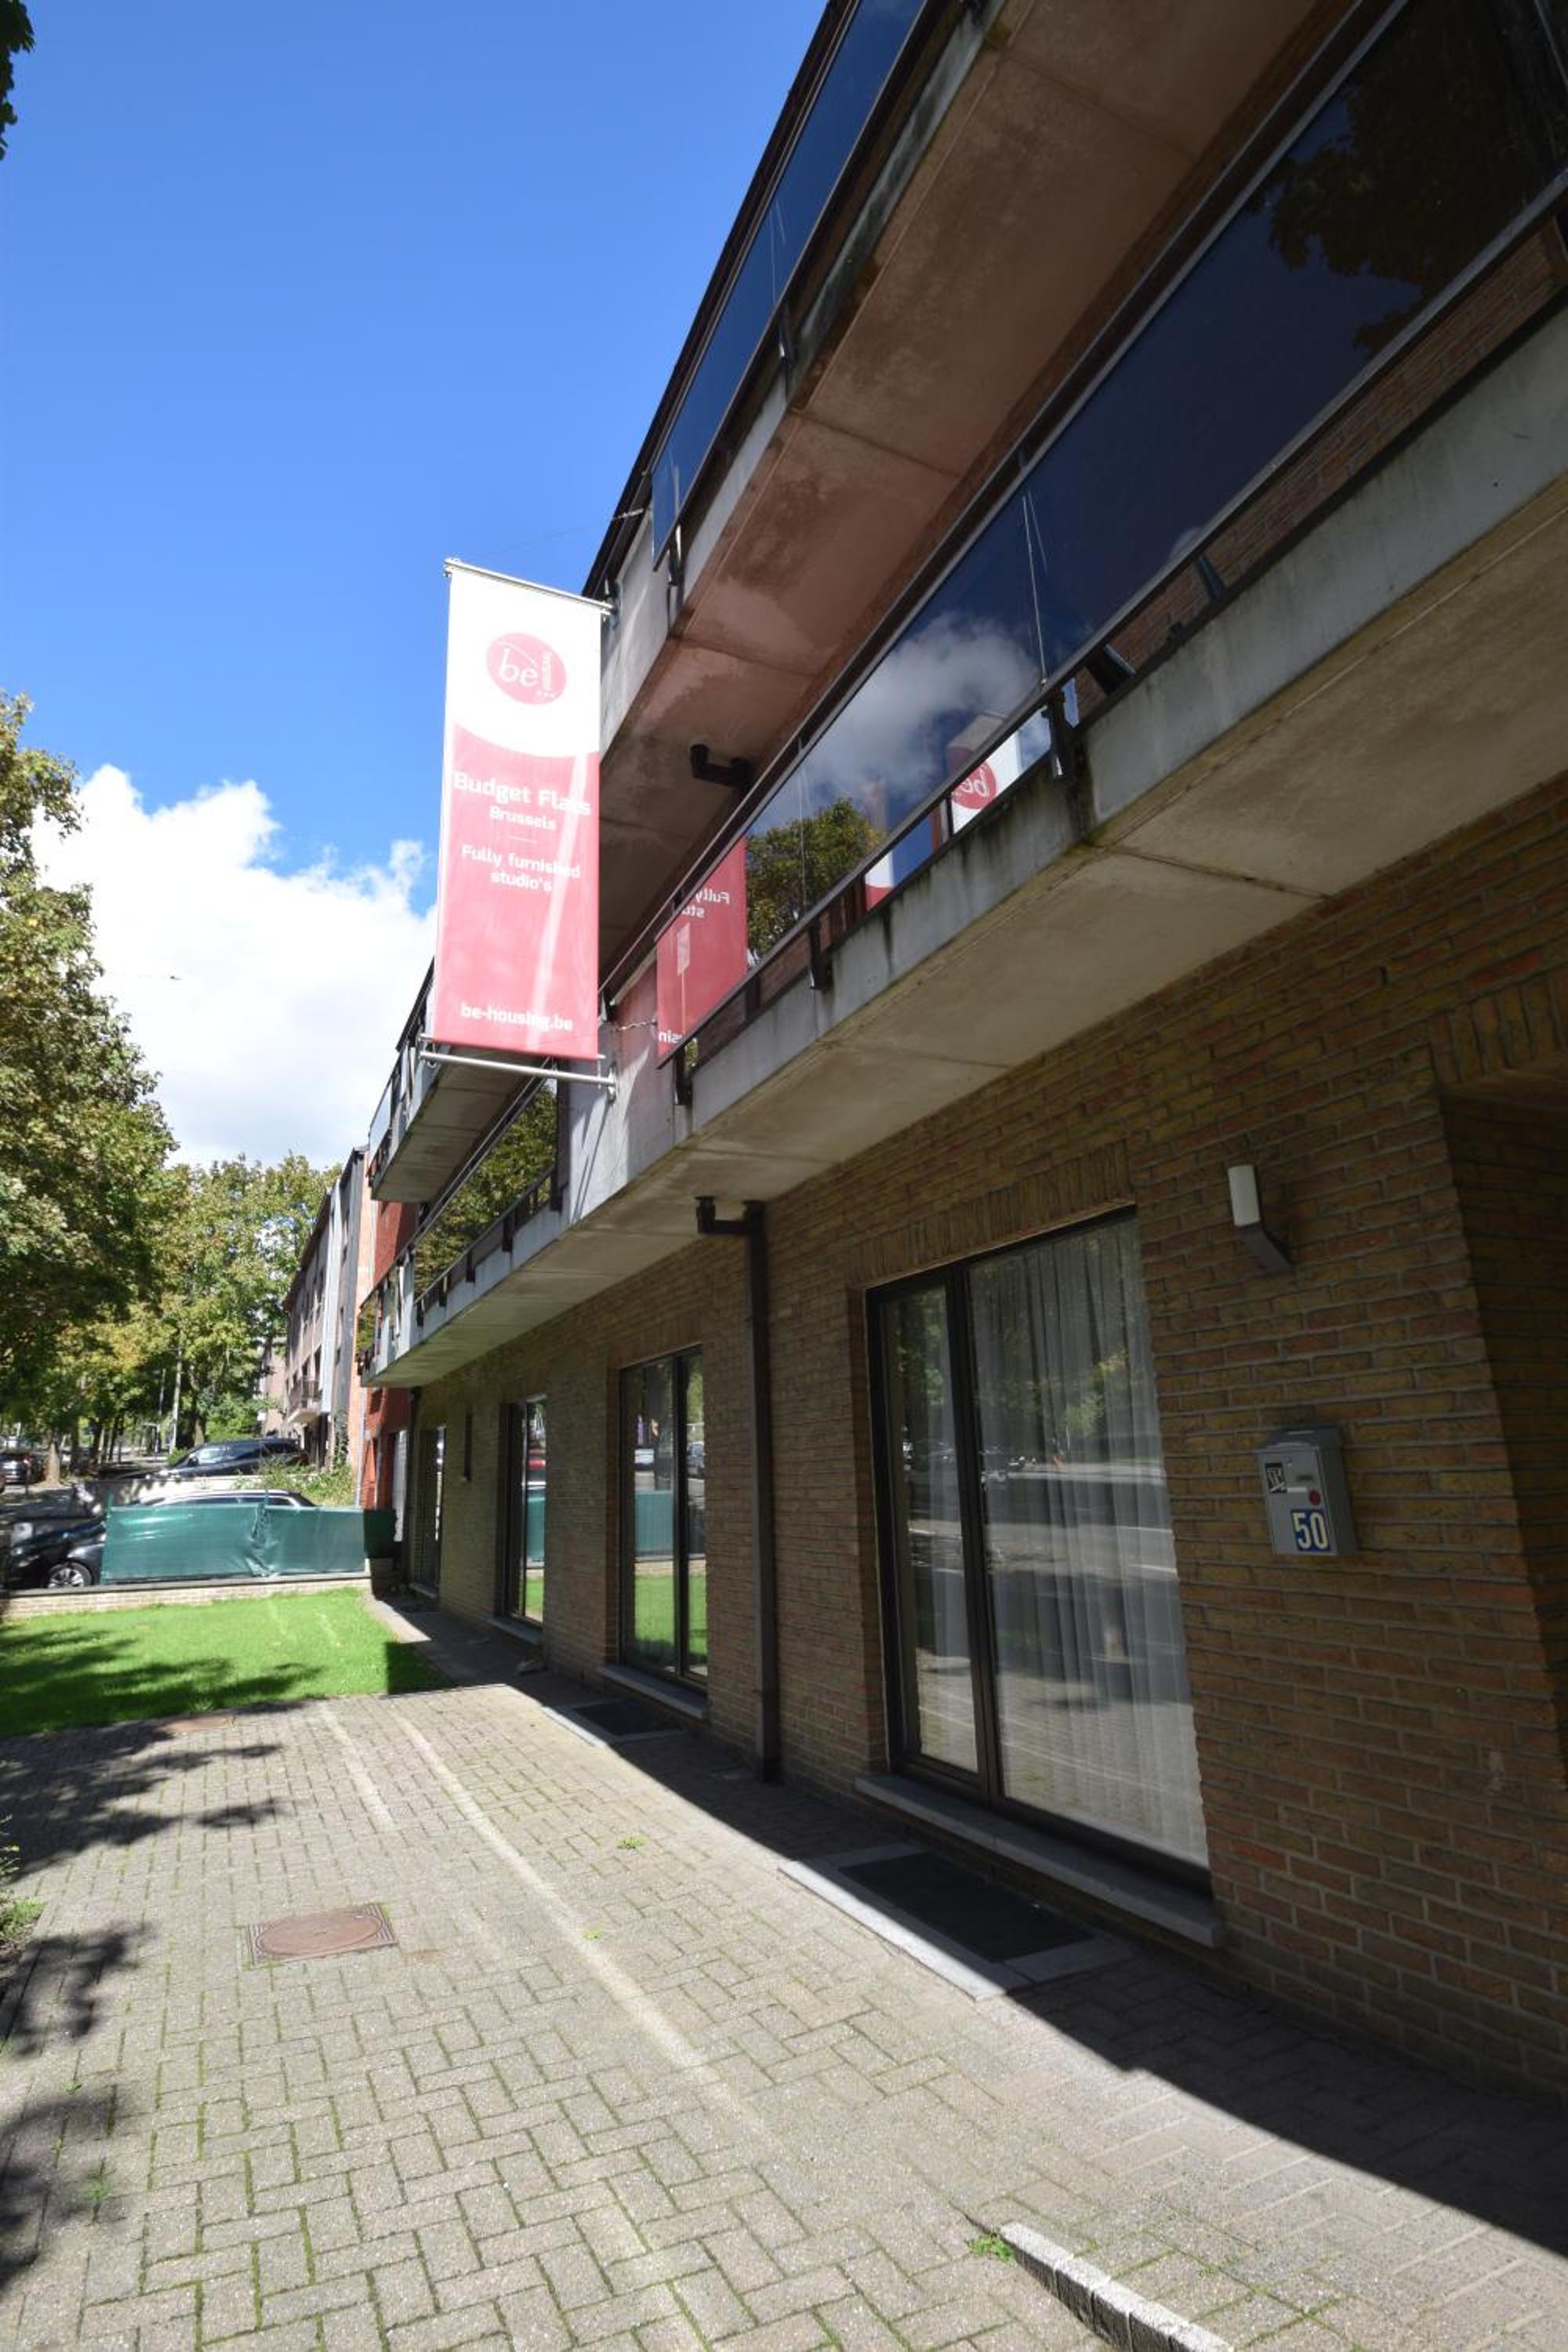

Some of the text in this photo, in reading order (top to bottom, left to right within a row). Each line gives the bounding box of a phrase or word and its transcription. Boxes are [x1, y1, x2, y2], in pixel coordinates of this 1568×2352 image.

[452, 771, 592, 816] Budget Flats
[489, 805, 557, 831] Brussels
[461, 844, 581, 879] Fully furnished
[490, 869, 553, 892] studio's
[460, 1003, 574, 1032] be-housing.be
[1292, 1512, 1329, 1551] 50
